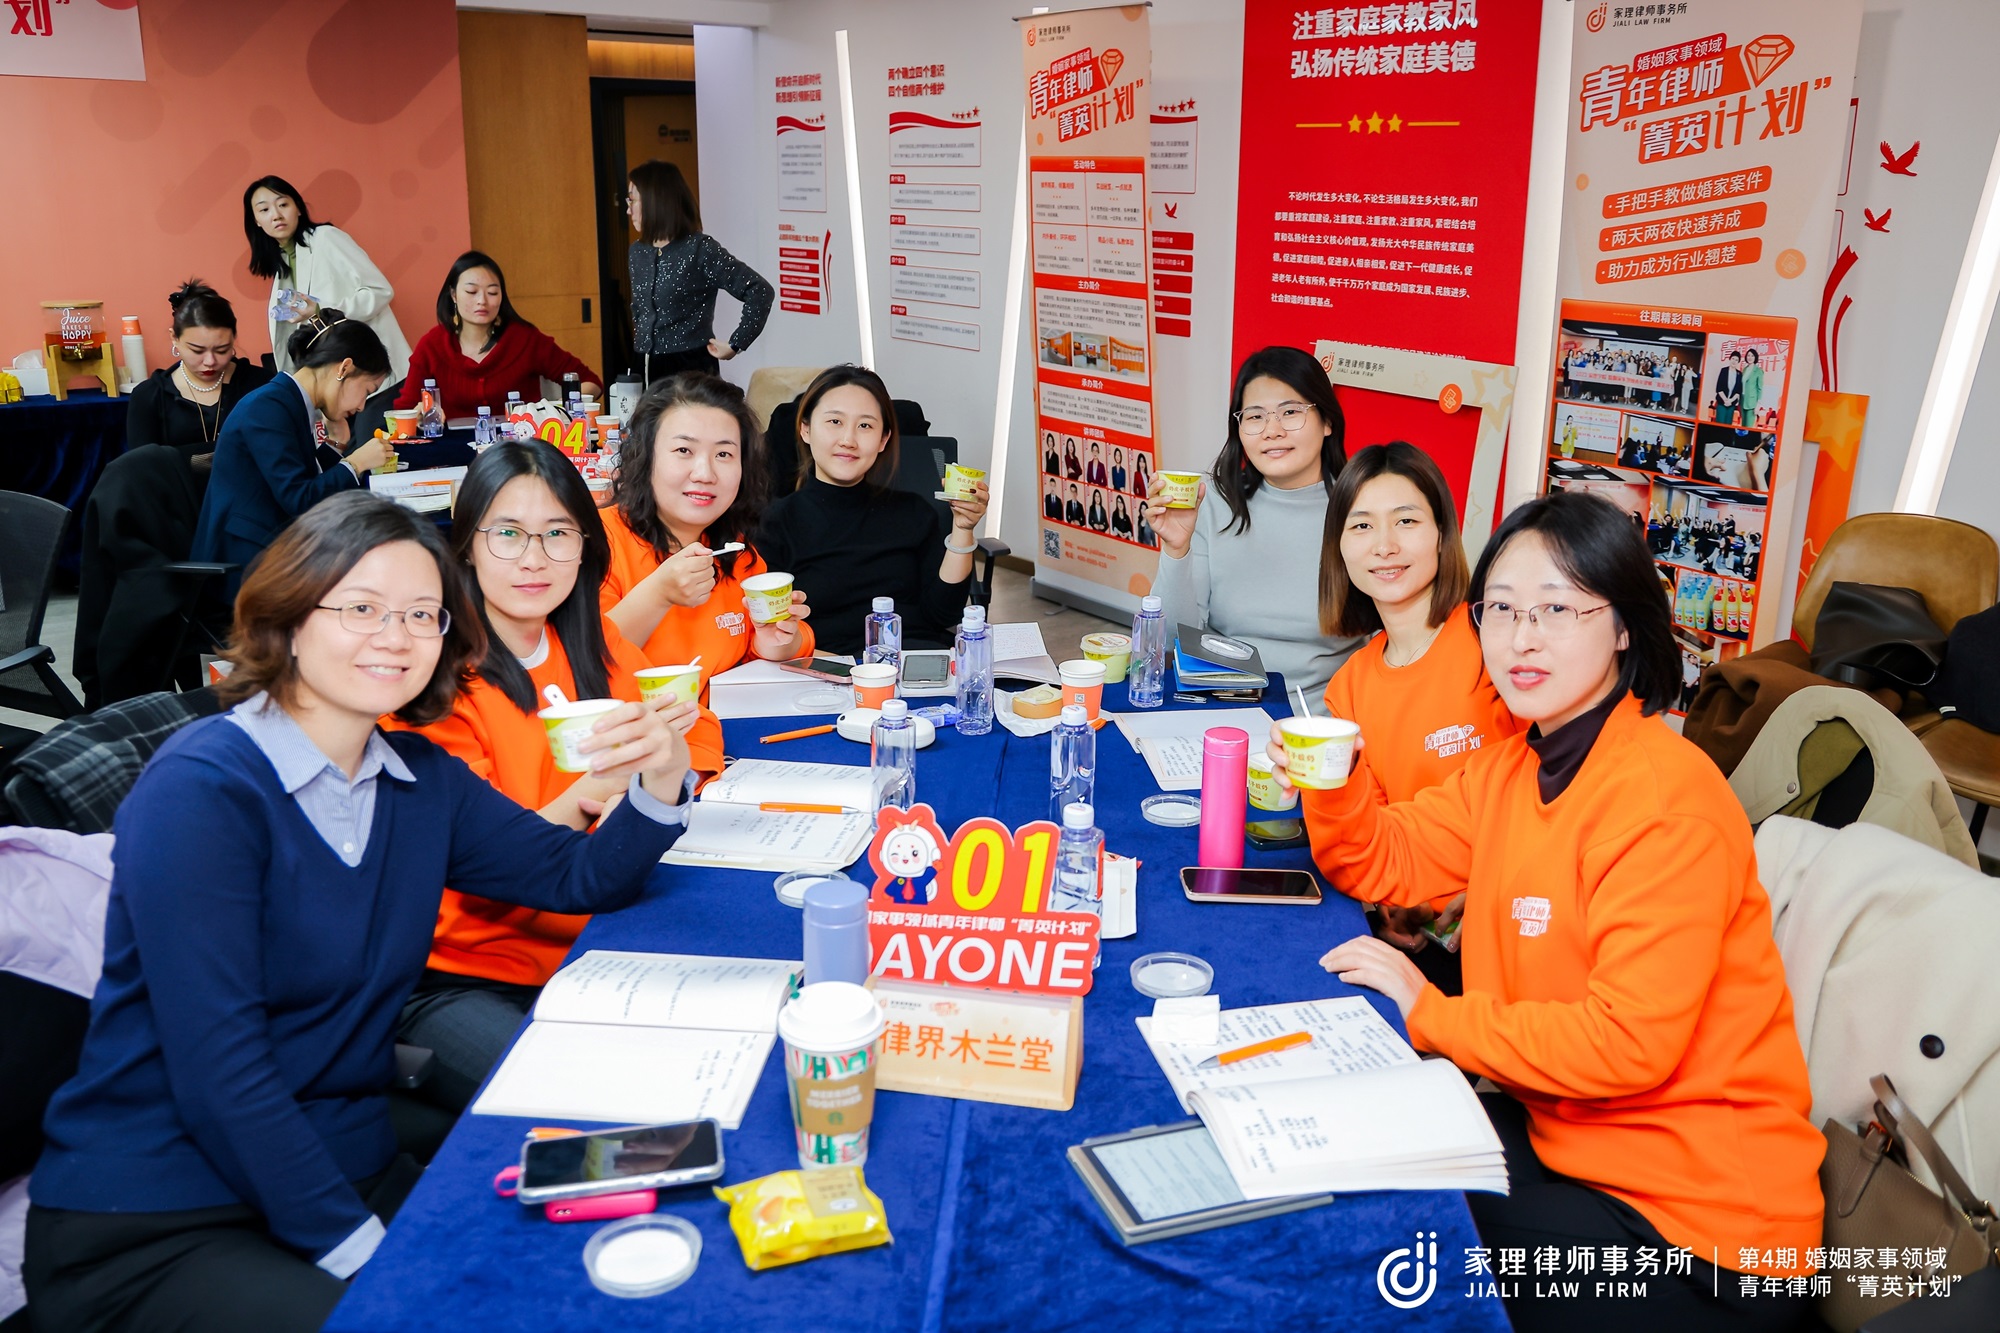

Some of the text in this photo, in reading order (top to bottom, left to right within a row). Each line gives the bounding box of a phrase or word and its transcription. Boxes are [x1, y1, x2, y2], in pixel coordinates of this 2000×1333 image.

[1292, 0, 1478, 41] 注重家庭家教家风
[1614, 2, 1687, 19] 家理律师事务所
[1634, 18, 1649, 26] LAW
[1653, 17, 1671, 25] FIRM
[1290, 40, 1477, 79] 弘扬传统家庭美德
[1637, 37, 1722, 72] 婚姻家事领域
[1030, 65, 1094, 117] 青年律师
[1049, 79, 1144, 139] “菁英计划”
[1583, 57, 1724, 128] 青年律师
[1623, 76, 1832, 160] “菁英计划”
[60, 308, 91, 325] Juice
[1639, 309, 1703, 328] 往期精彩瞬间
[1337, 357, 1385, 373] 家理律师事务所
[540, 421, 584, 455] 04
[951, 827, 1051, 913] 01
[868, 932, 1090, 988] AYONE
[879, 1020, 1054, 1073] 律界木兰堂
